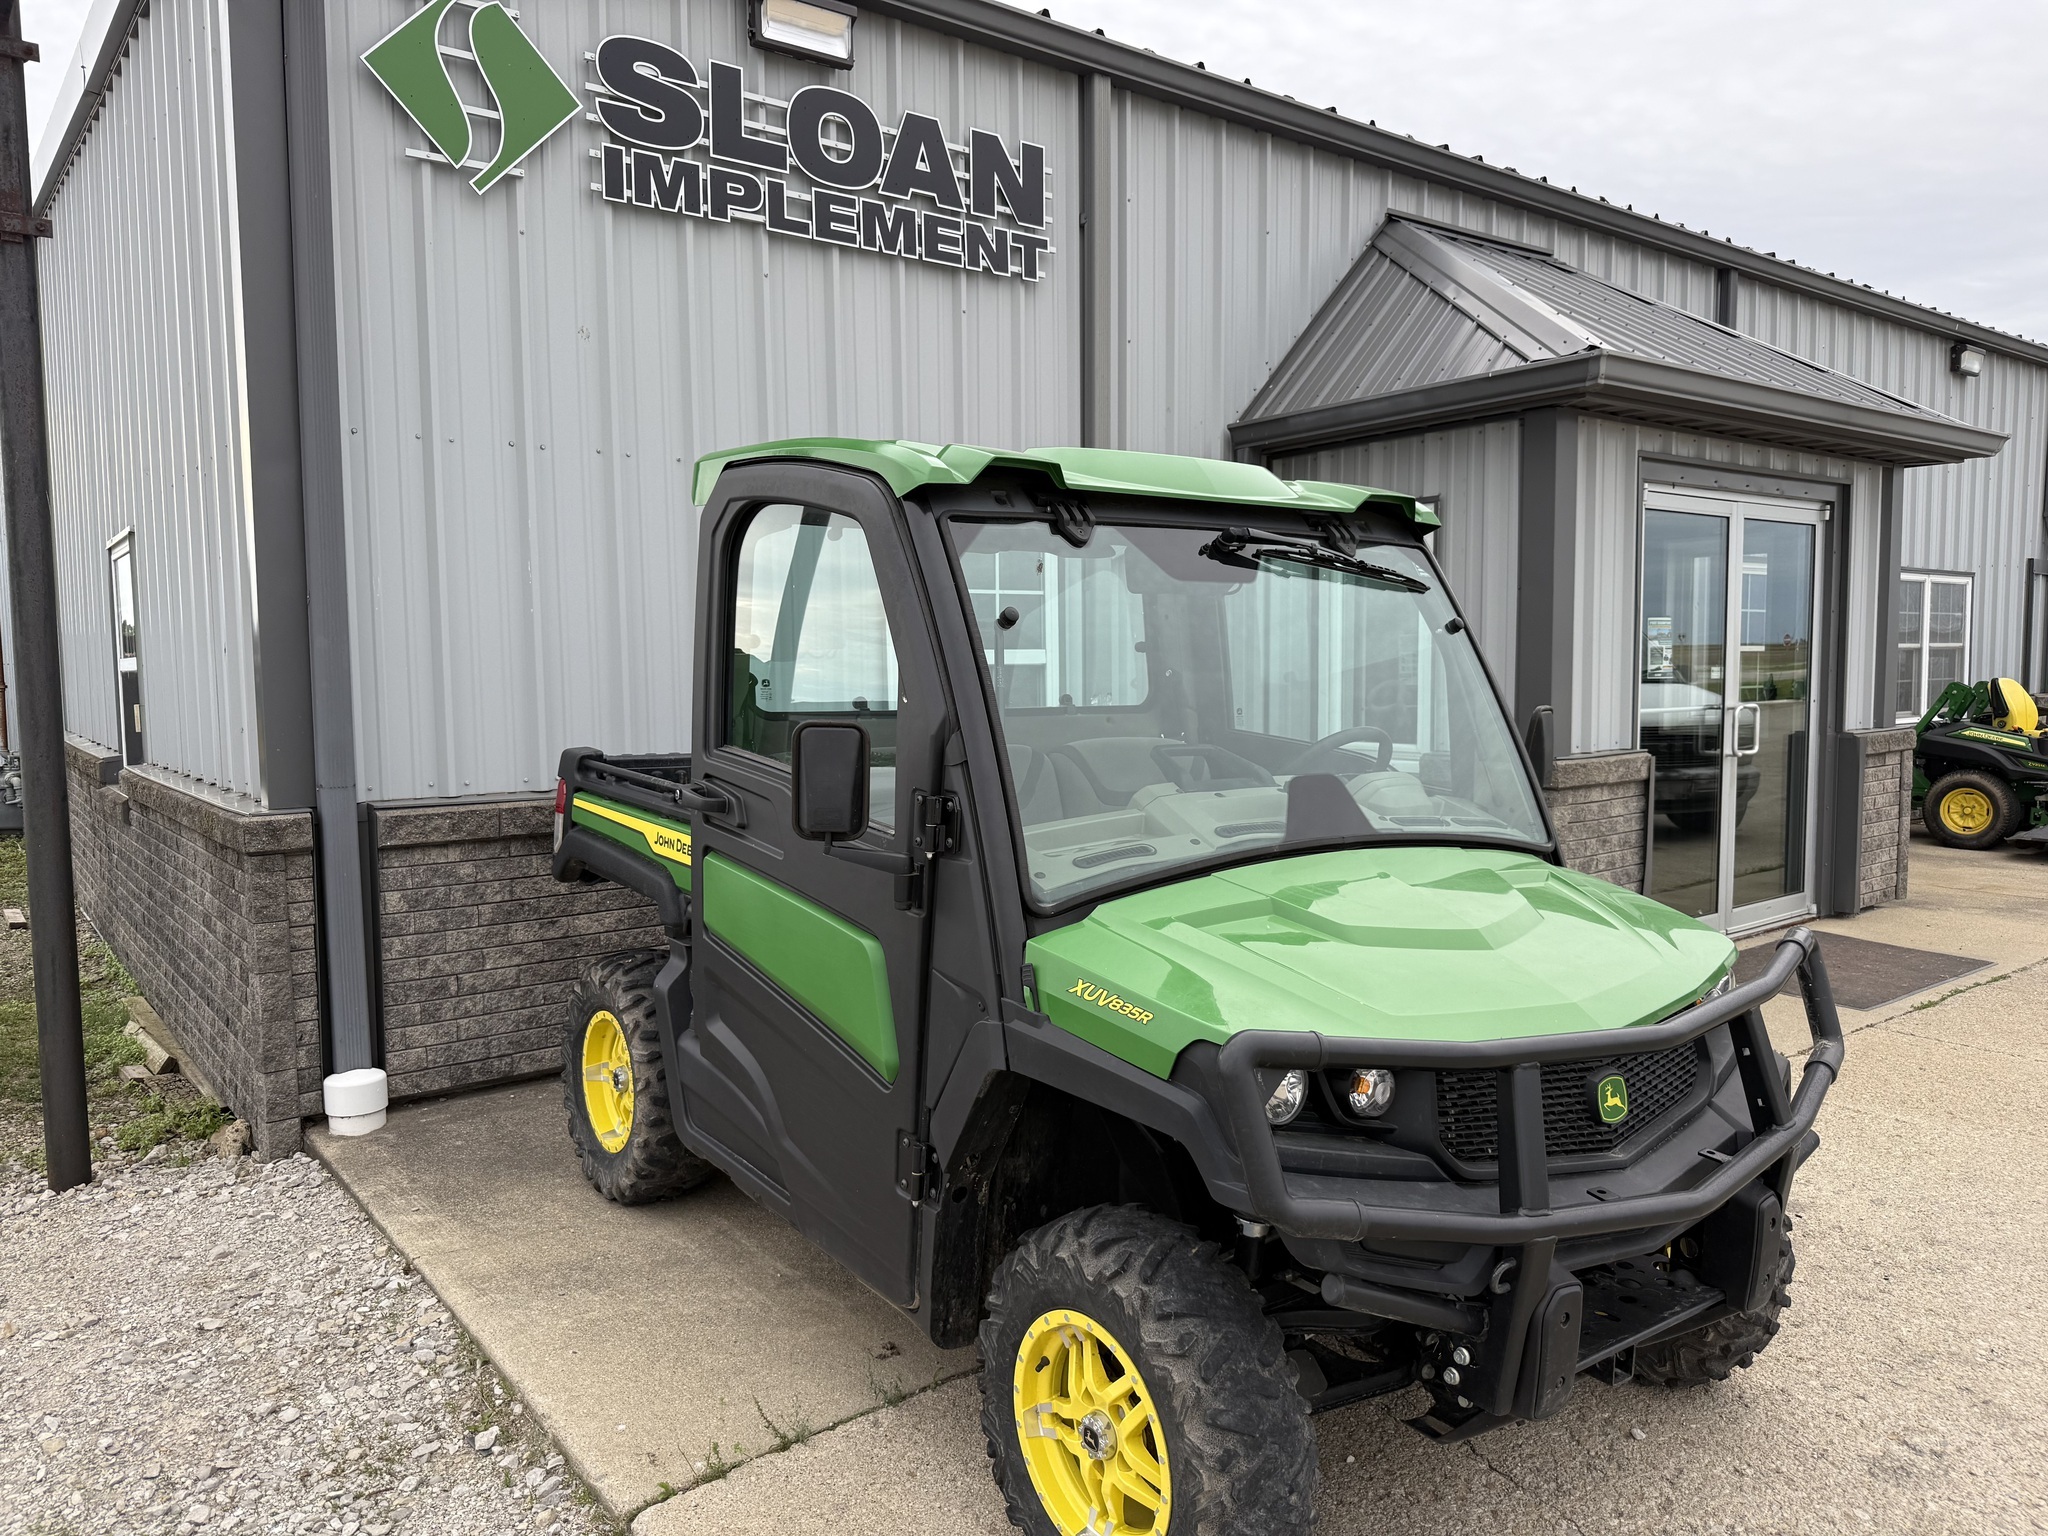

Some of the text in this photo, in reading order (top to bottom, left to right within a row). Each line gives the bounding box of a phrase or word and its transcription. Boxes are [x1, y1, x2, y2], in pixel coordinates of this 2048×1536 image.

[595, 35, 1045, 229] SLOAN
[602, 142, 1049, 281] IMPLEMENT
[654, 832, 675, 850] JOHN
[1066, 978, 1154, 1025] XUV835R
